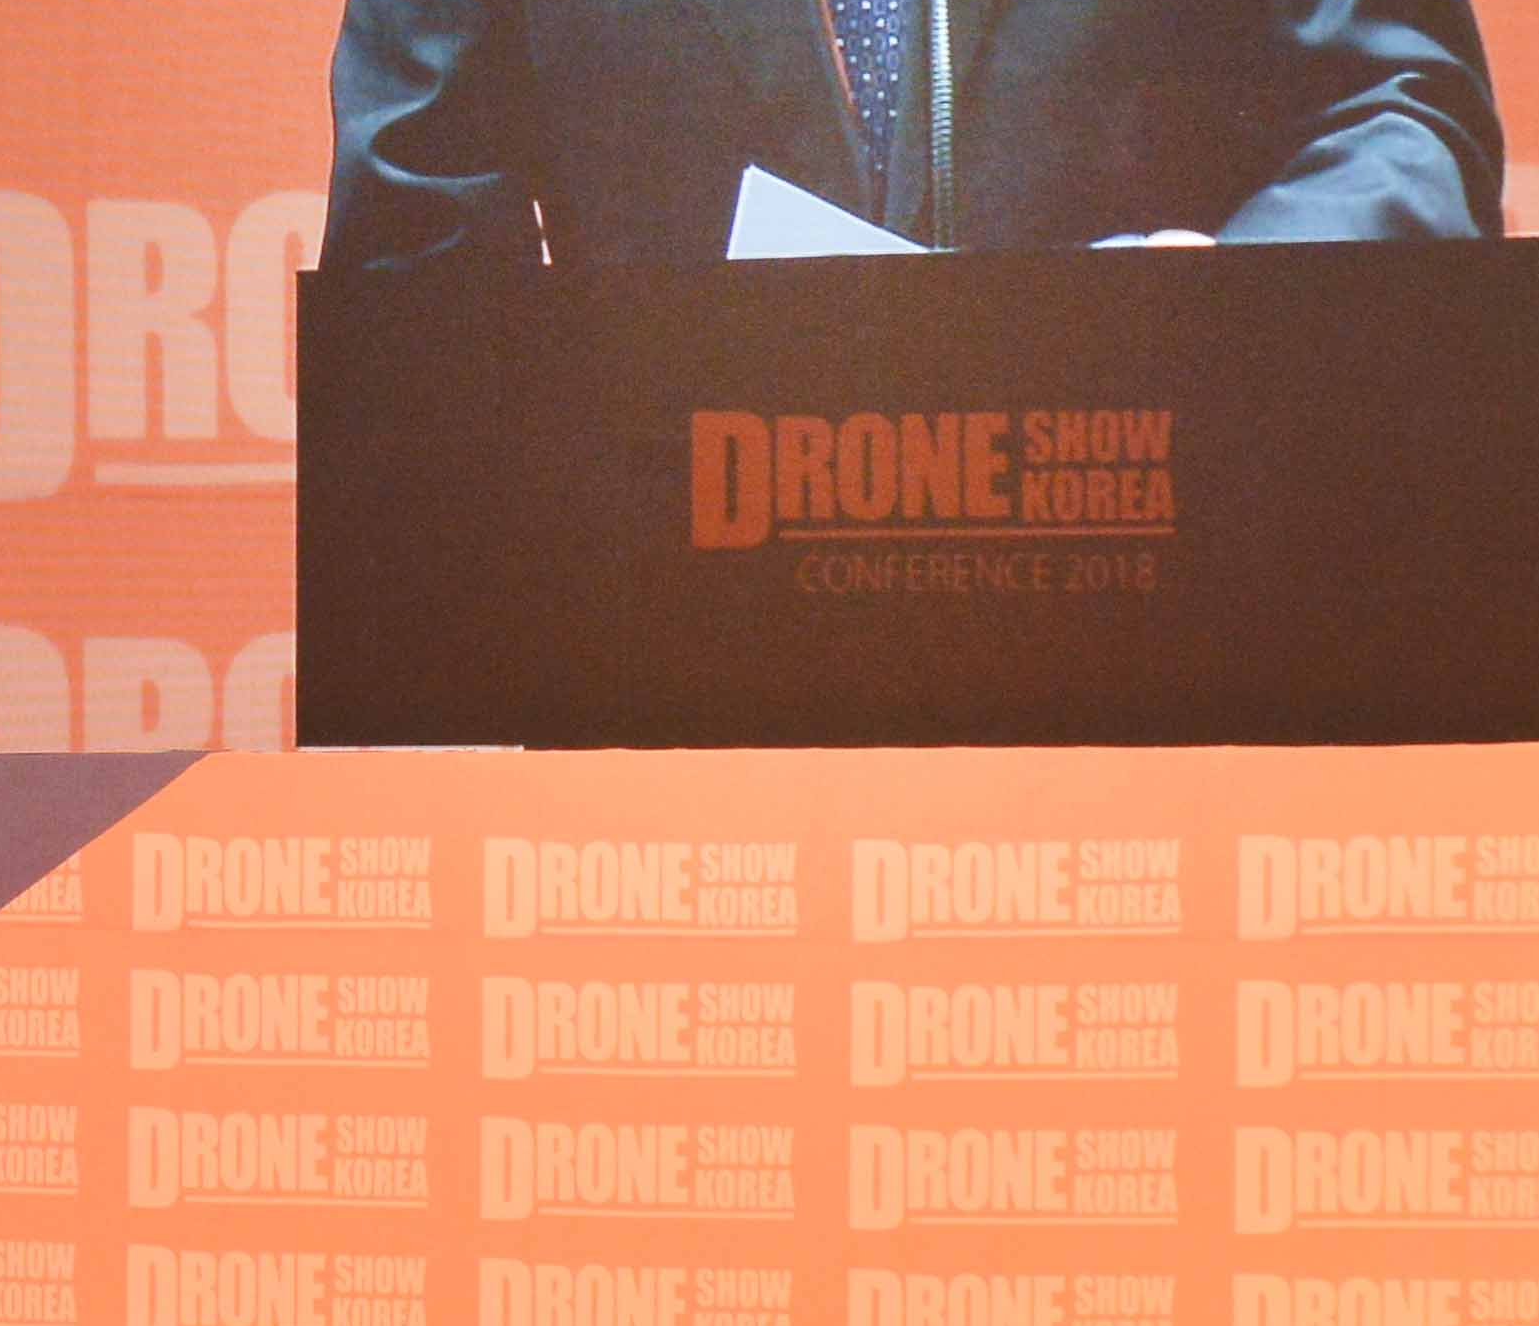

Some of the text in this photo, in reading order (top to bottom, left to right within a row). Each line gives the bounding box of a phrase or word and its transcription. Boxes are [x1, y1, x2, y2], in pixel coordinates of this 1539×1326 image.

[691, 409, 1172, 548] DRONE SHOW
[1023, 469, 1177, 522] KOREA
[795, 554, 1157, 595] CONFERENCE 2018
[131, 832, 431, 931] DRONE SHOW
[337, 879, 432, 919] KOREA
[483, 837, 798, 938] DRONE SHOW
[698, 886, 798, 926] KOREA
[853, 838, 1181, 943] DRONE SHOW
[1077, 883, 1182, 926] KOREA
[1237, 834, 1467, 941] DRONE
[130, 969, 429, 1069] DRONE SHOW
[335, 1018, 430, 1057] KOREA
[481, 976, 795, 1079] DRONE SHOW
[851, 981, 1179, 1087] DRONE SHOW
[1236, 980, 1466, 1089] DRONE
[697, 1026, 796, 1068] KOREA
[1075, 1028, 1180, 1069] KOREA
[128, 1106, 428, 1208] DRONE SHOW
[334, 1159, 428, 1198] KOREA
[480, 1115, 794, 1220] DRONE SHOW
[849, 1124, 1177, 1230] DRONE SHOW
[1234, 1126, 1463, 1234] DRONE
[695, 1169, 795, 1209] KOREA
[1074, 1173, 1178, 1216] KOREA
[334, 1255, 427, 1295] SHOW
[695, 1267, 793, 1309] SHOW
[1074, 1276, 1176, 1317] SHOW
